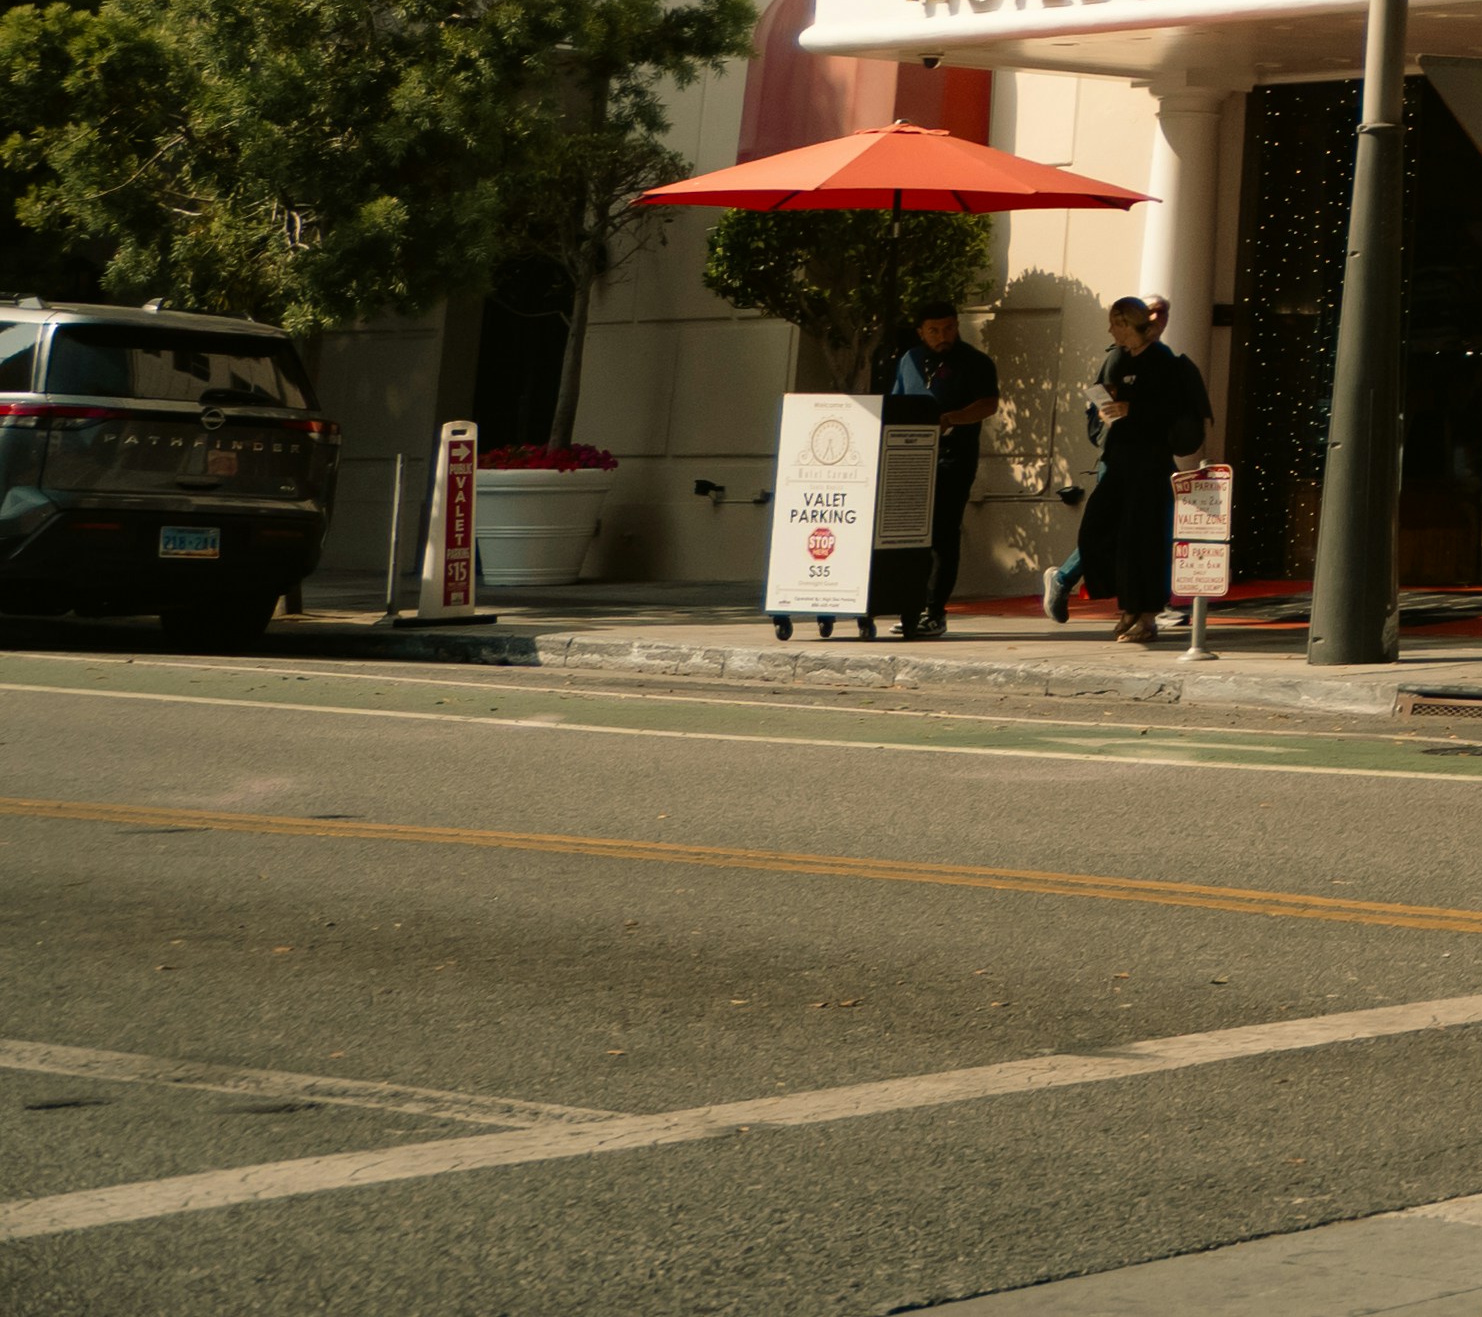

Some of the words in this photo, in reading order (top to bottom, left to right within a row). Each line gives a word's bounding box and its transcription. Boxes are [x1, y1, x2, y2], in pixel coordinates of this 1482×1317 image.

[104, 433, 300, 454] PATHFINDER
[1175, 481, 1191, 492] NO
[1194, 481, 1227, 492] PARKING
[803, 492, 848, 507] VALET
[454, 476, 467, 546] VALET
[789, 509, 858, 524] PARKING
[1178, 514, 1203, 525] VALET
[1206, 514, 1227, 525] ZONE
[809, 536, 835, 550] STOP
[1175, 546, 1188, 557] NO
[1192, 548, 1225, 557] PARKING
[447, 561, 467, 582] $15
[809, 565, 831, 578] $35
